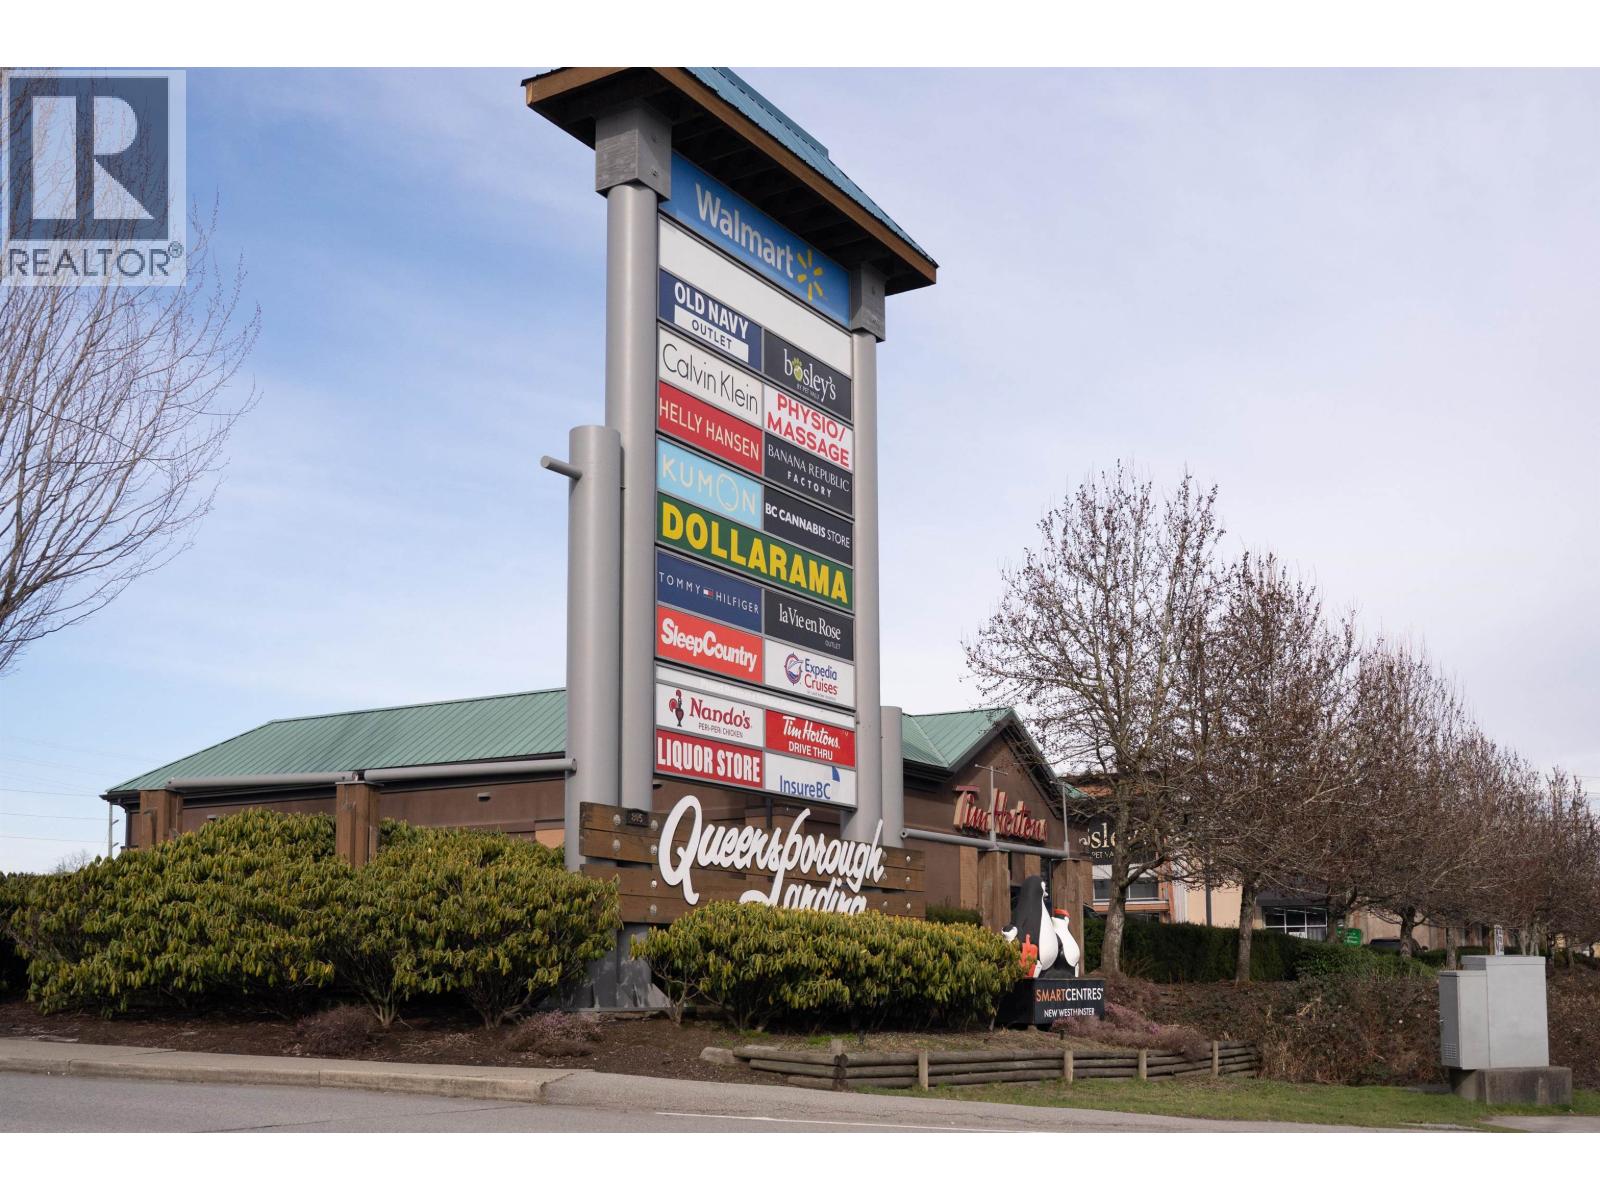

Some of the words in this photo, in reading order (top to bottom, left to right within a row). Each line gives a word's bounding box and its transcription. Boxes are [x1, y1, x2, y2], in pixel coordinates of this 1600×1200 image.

[695, 183, 793, 279] Walmart
[674, 282, 704, 315] OLD
[709, 299, 748, 340] NAVY
[692, 319, 732, 350] OUTLET
[663, 343, 716, 394] Calvin
[721, 371, 757, 415] Klein
[784, 348, 836, 402] bosley's
[659, 398, 702, 434] HELLY
[706, 420, 759, 461] HANSEN
[767, 411, 849, 467] MASSAGE
[778, 393, 846, 442] PHYSIO/
[662, 454, 756, 515] KUMON
[768, 444, 807, 472] BANANA
[808, 463, 850, 492] REPUBLIC
[787, 471, 832, 498] FACTORY
[765, 502, 778, 517] BC
[779, 509, 826, 538] CANNABIS
[826, 530, 850, 549] STORE
[662, 501, 848, 604] DOLLARAMA
[659, 571, 701, 595] TOMMY
[715, 588, 760, 615] HILFIGER
[805, 618, 818, 633] en
[818, 617, 841, 640] Rose
[804, 658, 837, 680] Expedia
[804, 673, 838, 695] Cruises
[689, 697, 751, 730] Nando's
[782, 715, 801, 739] Tim
[657, 737, 713, 774] LIQUOR
[717, 749, 761, 783] STORE
[788, 741, 812, 756] DRIVE
[813, 746, 833, 761] THRU
[779, 775, 831, 800] InsureBC
[658, 795, 884, 905] Queensborough
[1044, 1008, 1057, 1018] NEW
[1058, 1007, 1095, 1017] WESTMINSTER
